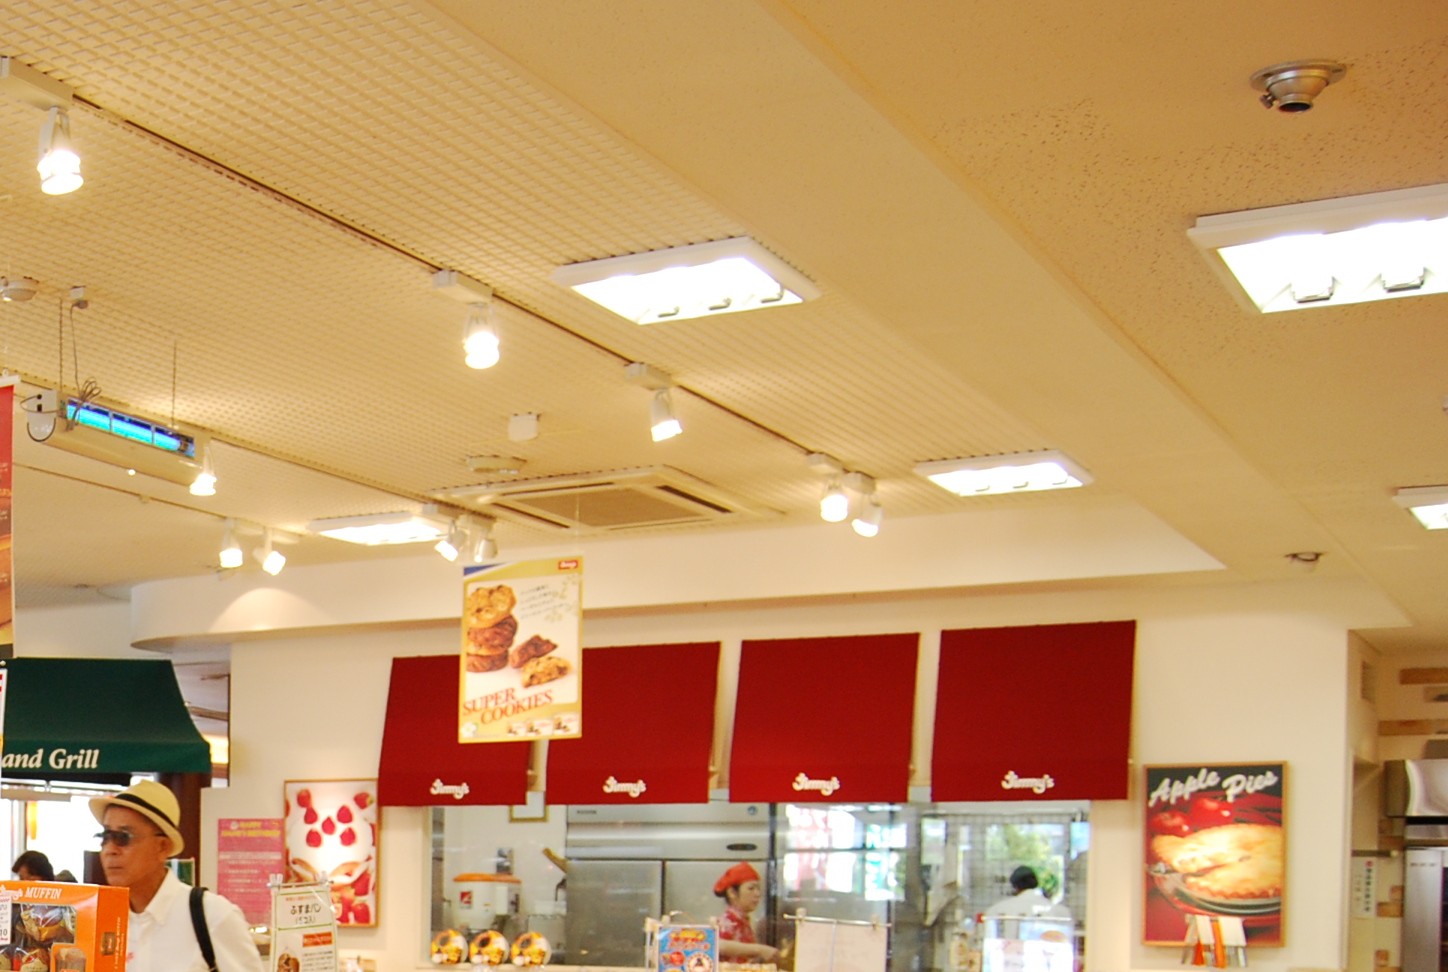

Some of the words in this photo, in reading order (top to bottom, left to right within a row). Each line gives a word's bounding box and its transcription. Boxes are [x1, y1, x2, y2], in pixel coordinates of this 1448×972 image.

[463, 687, 517, 717] SUPER
[480, 689, 554, 725] COOKIES
[49, 748, 100, 770] Grill
[429, 778, 470, 800] Jimmy's
[603, 775, 647, 798] Jimmy's
[792, 772, 840, 796] Jimmy's
[1000, 769, 1055, 794] Jimmy's
[1148, 767, 1221, 807] Apple
[1222, 770, 1279, 803] Pies
[25, 887, 62, 899] MUFFIN
